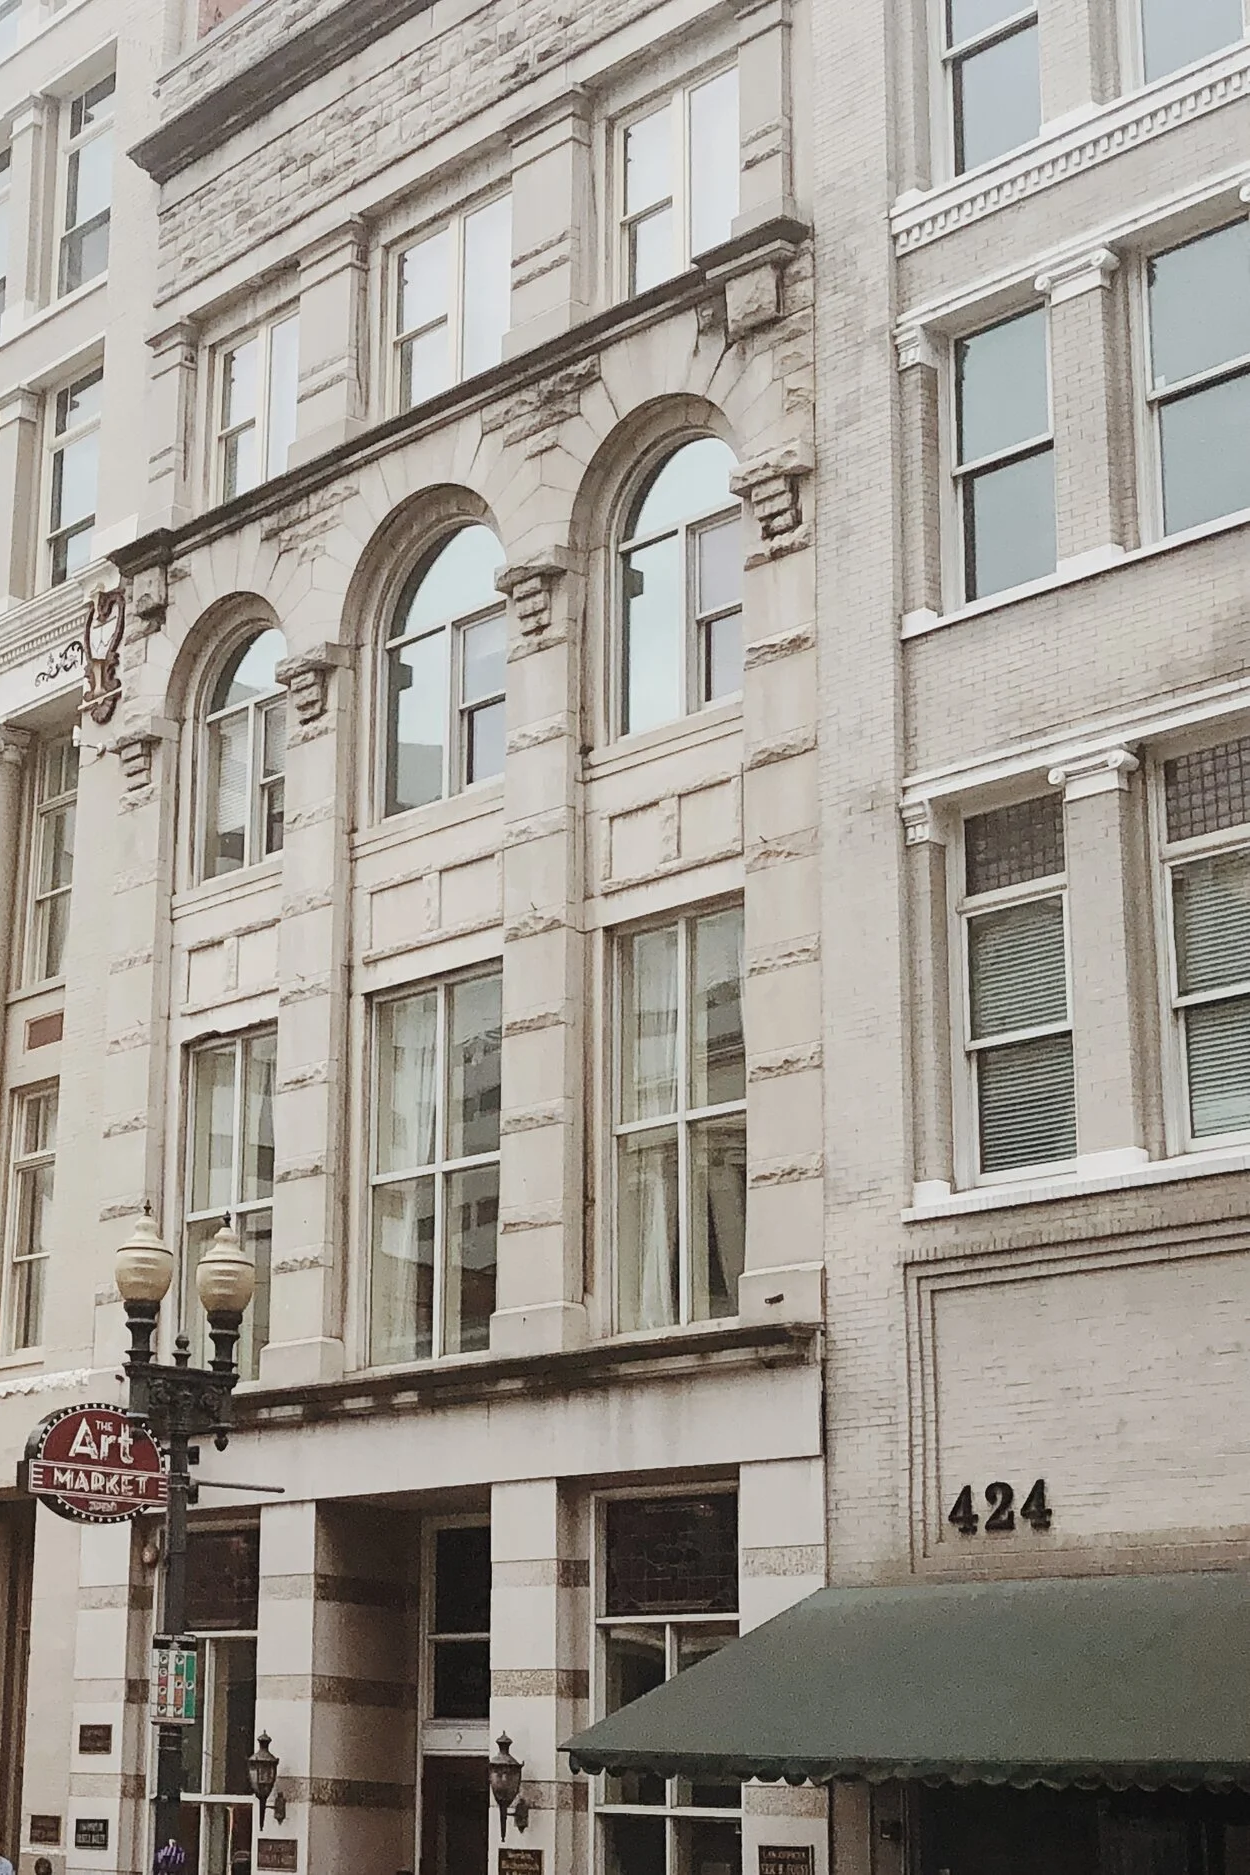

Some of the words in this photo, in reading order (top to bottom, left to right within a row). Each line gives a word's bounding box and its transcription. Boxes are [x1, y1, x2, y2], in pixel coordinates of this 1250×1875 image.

[68, 1416, 134, 1465] Art
[95, 1419, 113, 1432] THE
[53, 1467, 149, 1497] MARKET
[948, 1478, 1053, 1535] 424
